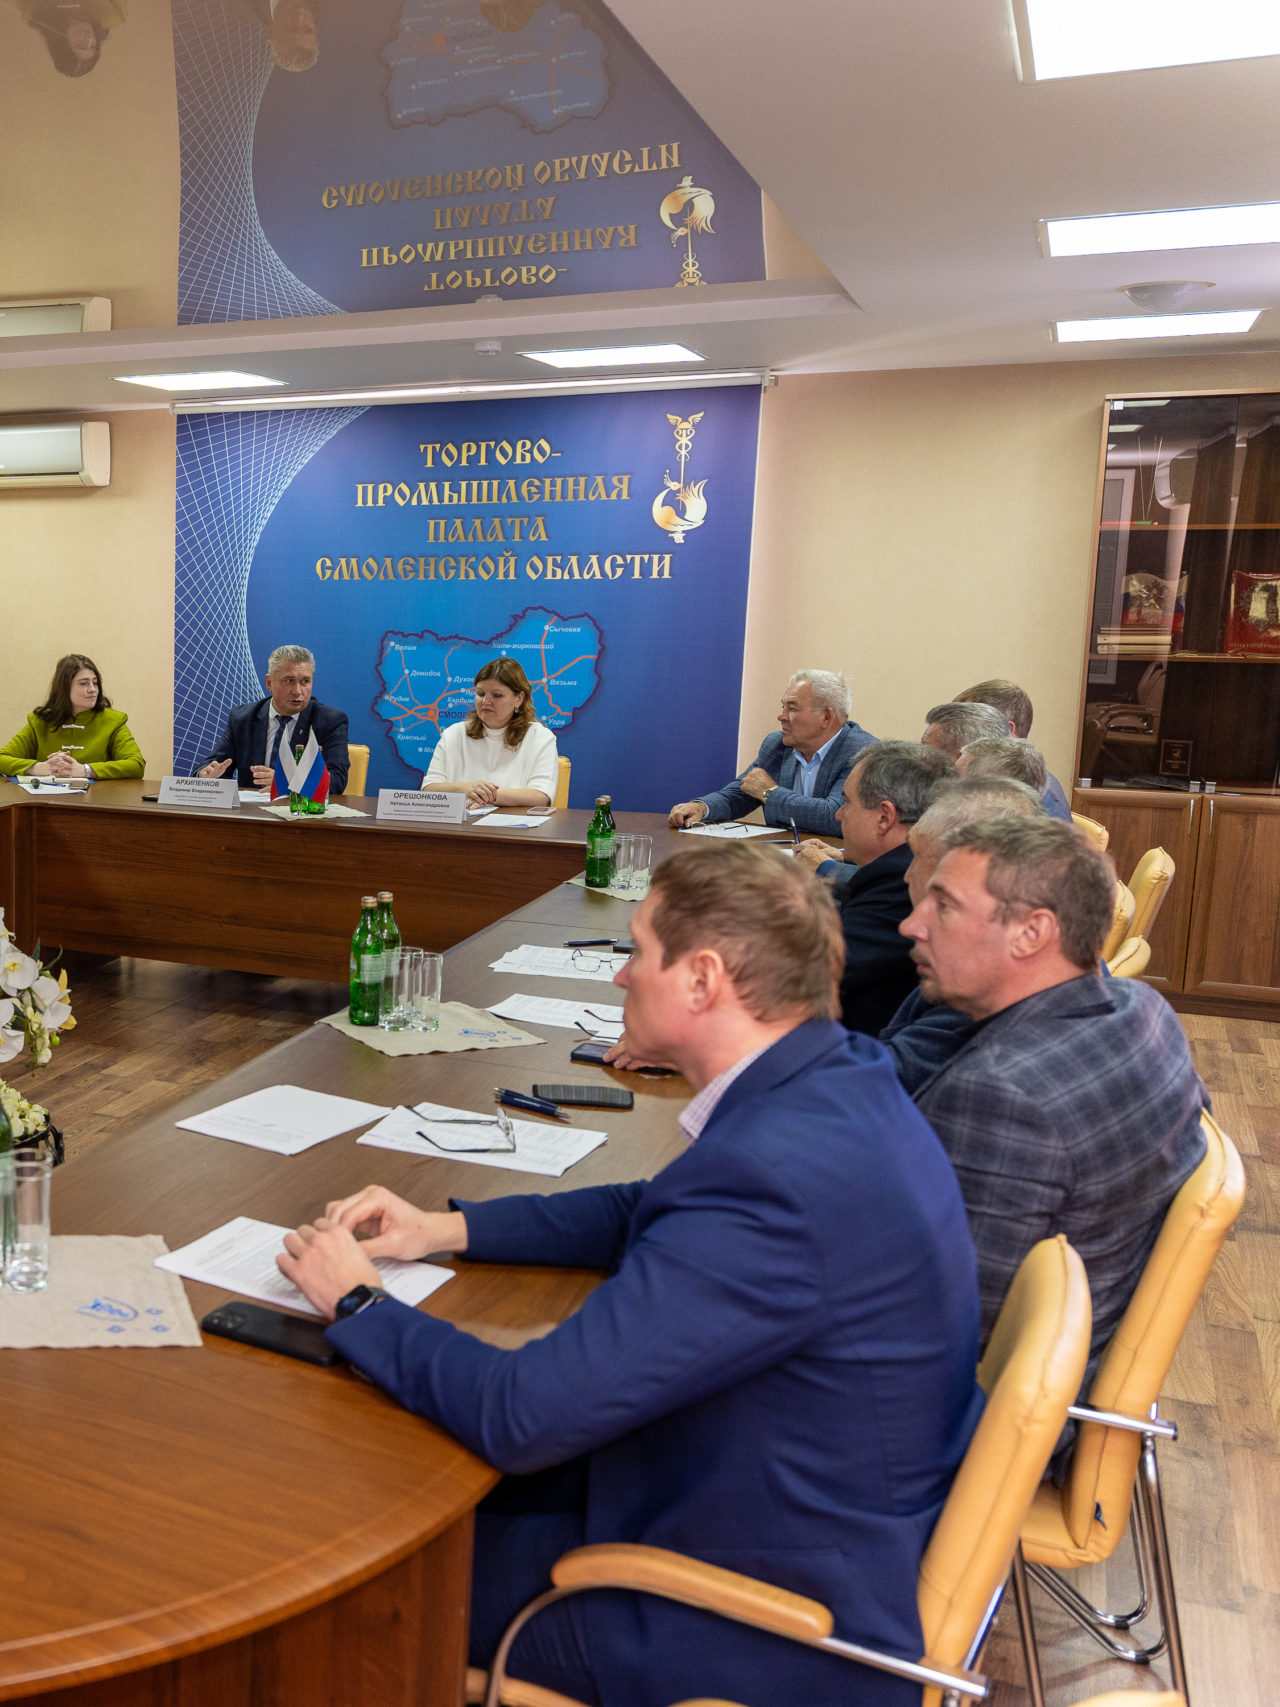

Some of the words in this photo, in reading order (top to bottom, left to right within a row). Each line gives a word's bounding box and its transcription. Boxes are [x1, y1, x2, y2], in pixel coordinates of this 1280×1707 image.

[420, 438, 562, 468] ТОРГОВО-
[355, 475, 632, 507] ПРОМЫШЛЕННАЯ
[427, 516, 549, 543] ПАЛАТА
[315, 550, 518, 581] СМОЛЕНСКОЙ
[526, 553, 673, 580] ОБЛАСТИ
[438, 711, 468, 719] СМОЛЕ
[175, 779, 220, 787] АРХИПЕНКОВ
[393, 792, 448, 801] ОРЕШОНКОВА
